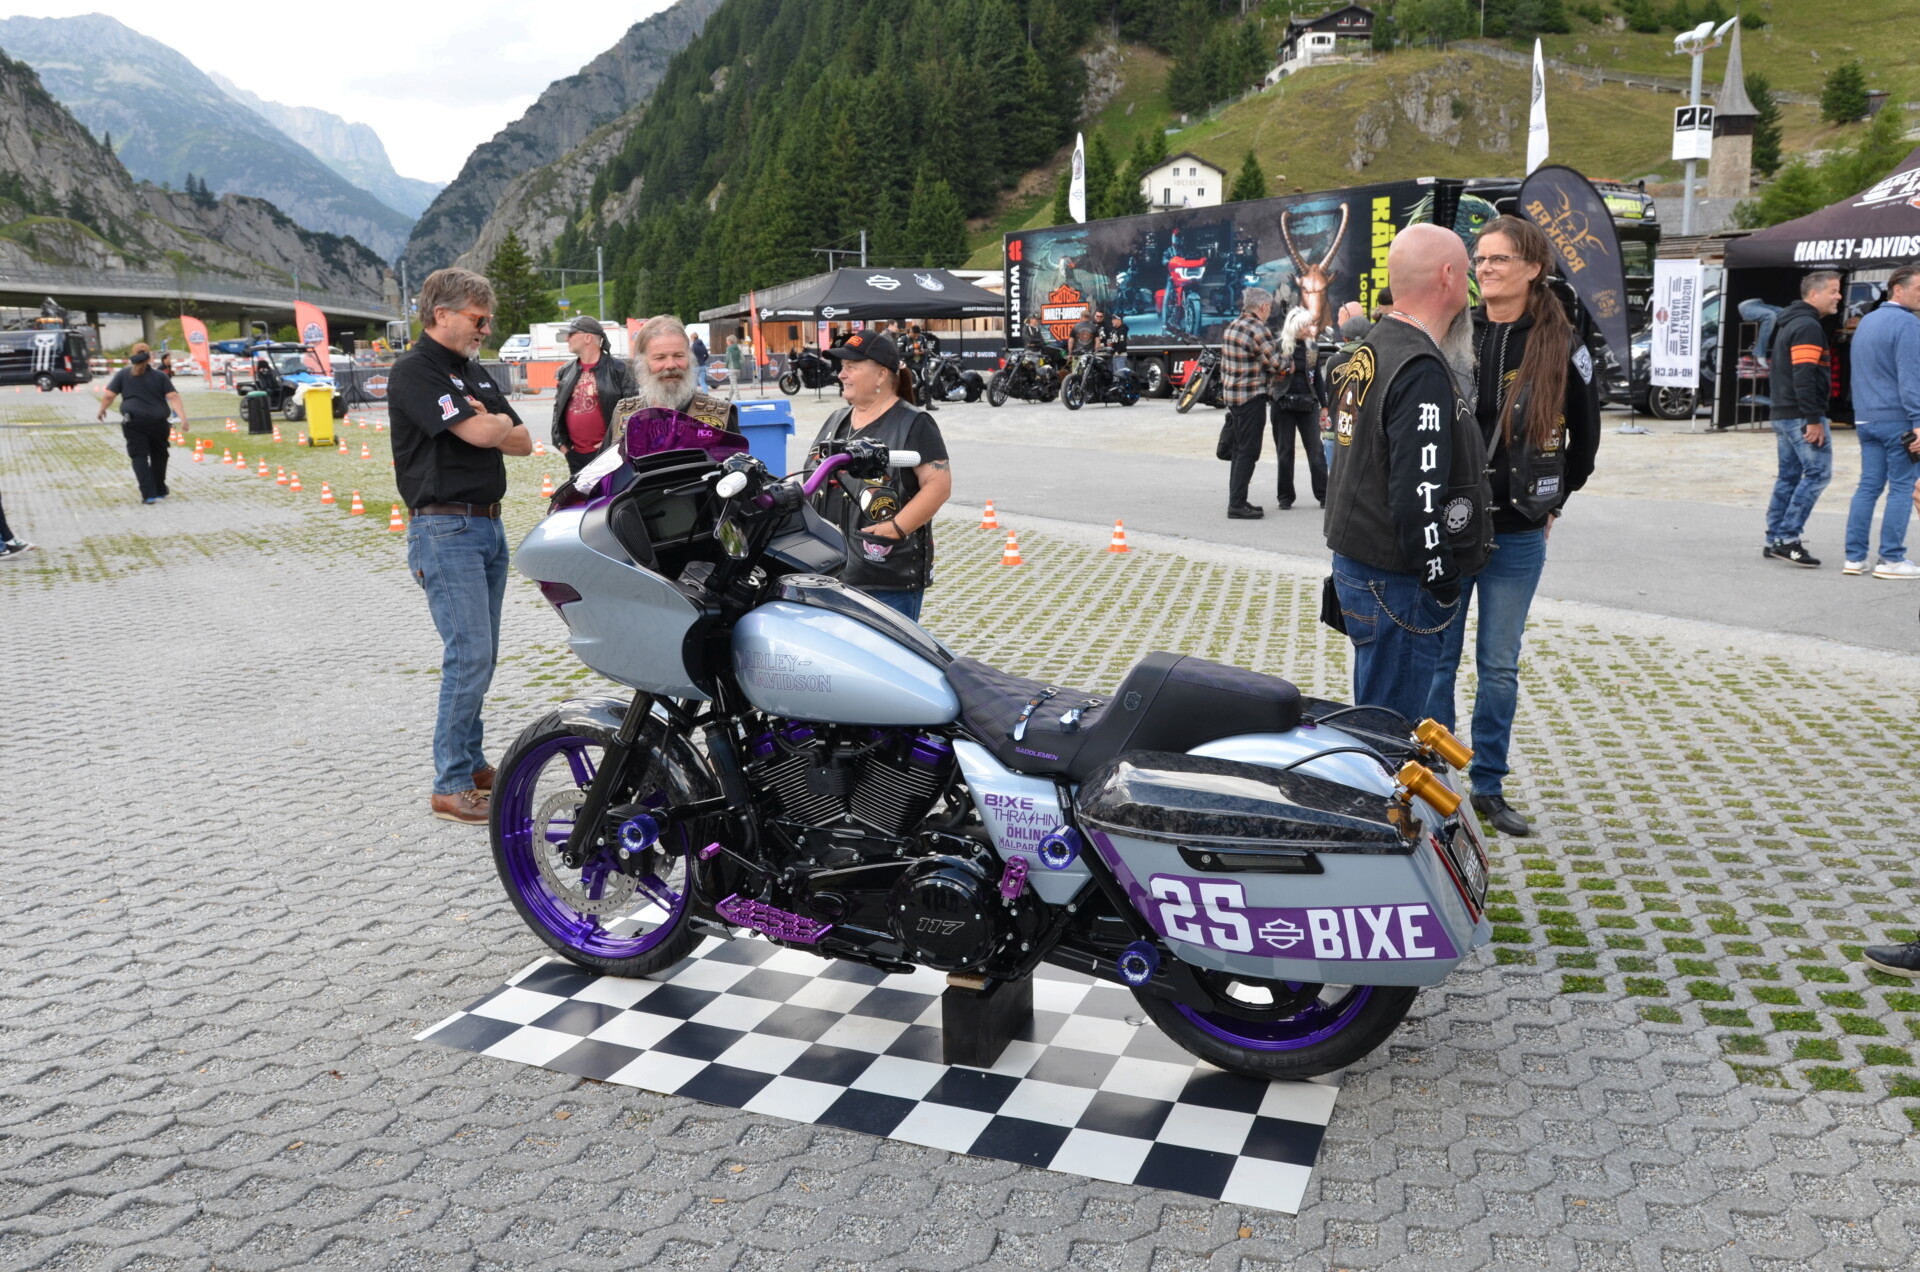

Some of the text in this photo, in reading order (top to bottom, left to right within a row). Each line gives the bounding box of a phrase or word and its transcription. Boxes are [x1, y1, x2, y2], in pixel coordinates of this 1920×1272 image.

[1794, 235, 1920, 262] HARLEY-DAVIDS
[747, 669, 832, 693] DAVIDSON
[1015, 746, 1059, 761] SADDLEMEN
[916, 917, 966, 936] 117
[1150, 877, 1254, 953] 25
[1306, 905, 1436, 960] BIXE
